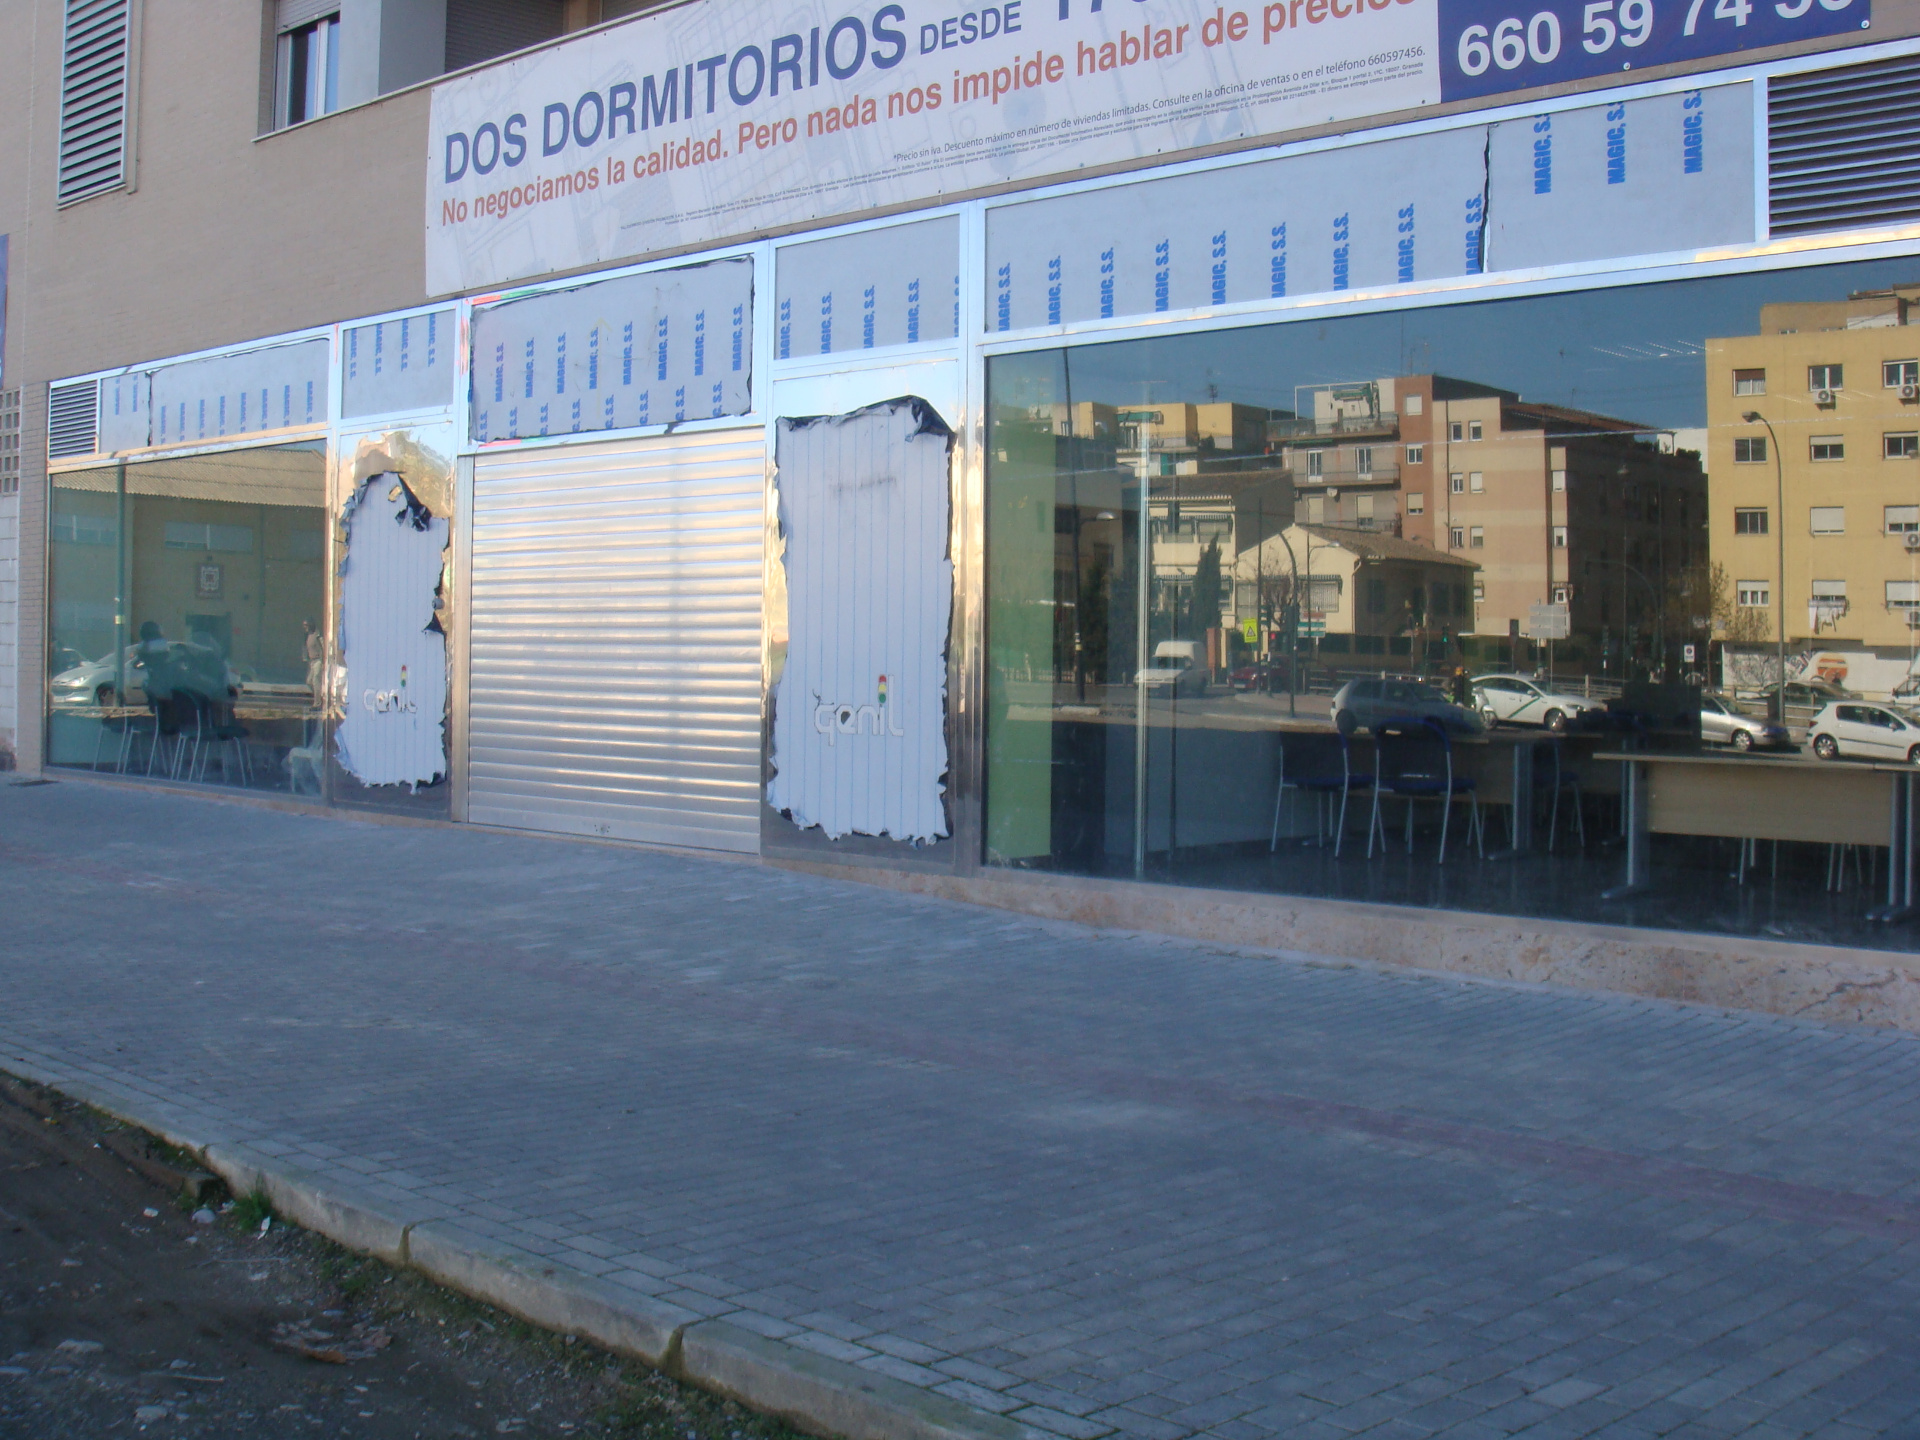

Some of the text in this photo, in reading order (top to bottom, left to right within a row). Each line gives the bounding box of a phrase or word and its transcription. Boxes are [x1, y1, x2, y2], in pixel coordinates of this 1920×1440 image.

[1458, 11, 1561, 76] 660
[1583, 0, 1653, 54] 59
[444, 113, 527, 184] DOS
[542, 4, 906, 158] DORMITORIOS
[920, 0, 1022, 55] DESDE
[919, 149, 929, 157] sin
[944, 139, 983, 153] Descuento
[985, 132, 1015, 144] máximo
[1016, 129, 1027, 137] en
[1028, 123, 1059, 135] número
[1061, 119, 1072, 128] de
[1072, 111, 1111, 127] viviendas
[1111, 103, 1151, 118] limitadas.
[1152, 94, 1191, 110] Consulte
[1192, 92, 1203, 101] en
[1204, 89, 1213, 98] la
[1214, 84, 1246, 97] oficina
[1247, 80, 1259, 90] de
[1260, 75, 1291, 88] ventas
[1292, 73, 1299, 81] o
[1301, 70, 1313, 79] en
[1315, 65, 1324, 76] el
[1325, 60, 1366, 75] teléfono
[1367, 46, 1426, 67] 660597456.
[442, 199, 468, 225] No
[475, 167, 600, 219] negociamos
[607, 157, 625, 184] la
[633, 129, 729, 179] calidad.
[738, 118, 798, 153] Pero
[807, 95, 877, 137] nada
[887, 83, 942, 118] nos
[953, 49, 1065, 104] impide
[1077, 24, 1190, 75] hablar
[1201, 8, 1249, 47] de
[1263, 0, 1414, 44] preci
[1607, 123, 1628, 185] MAGIC,
[1683, 111, 1705, 175] MAGIC,
[1533, 135, 1554, 195] MAGIC,
[1397, 202, 1415, 233] S.S.
[1465, 192, 1483, 224] S.S.
[1271, 222, 1287, 250] S.S.
[1332, 212, 1350, 242] S.S.
[1154, 238, 1170, 267] S.S.
[1211, 230, 1227, 259] S.S.
[1047, 257, 1062, 282] S.S.
[1100, 246, 1115, 274] S.S.
[997, 262, 1011, 289] S.S.
[820, 293, 833, 316] S.S.
[863, 285, 875, 310] S.S.
[907, 279, 920, 303] S.S.
[779, 298, 791, 322] S.S.
